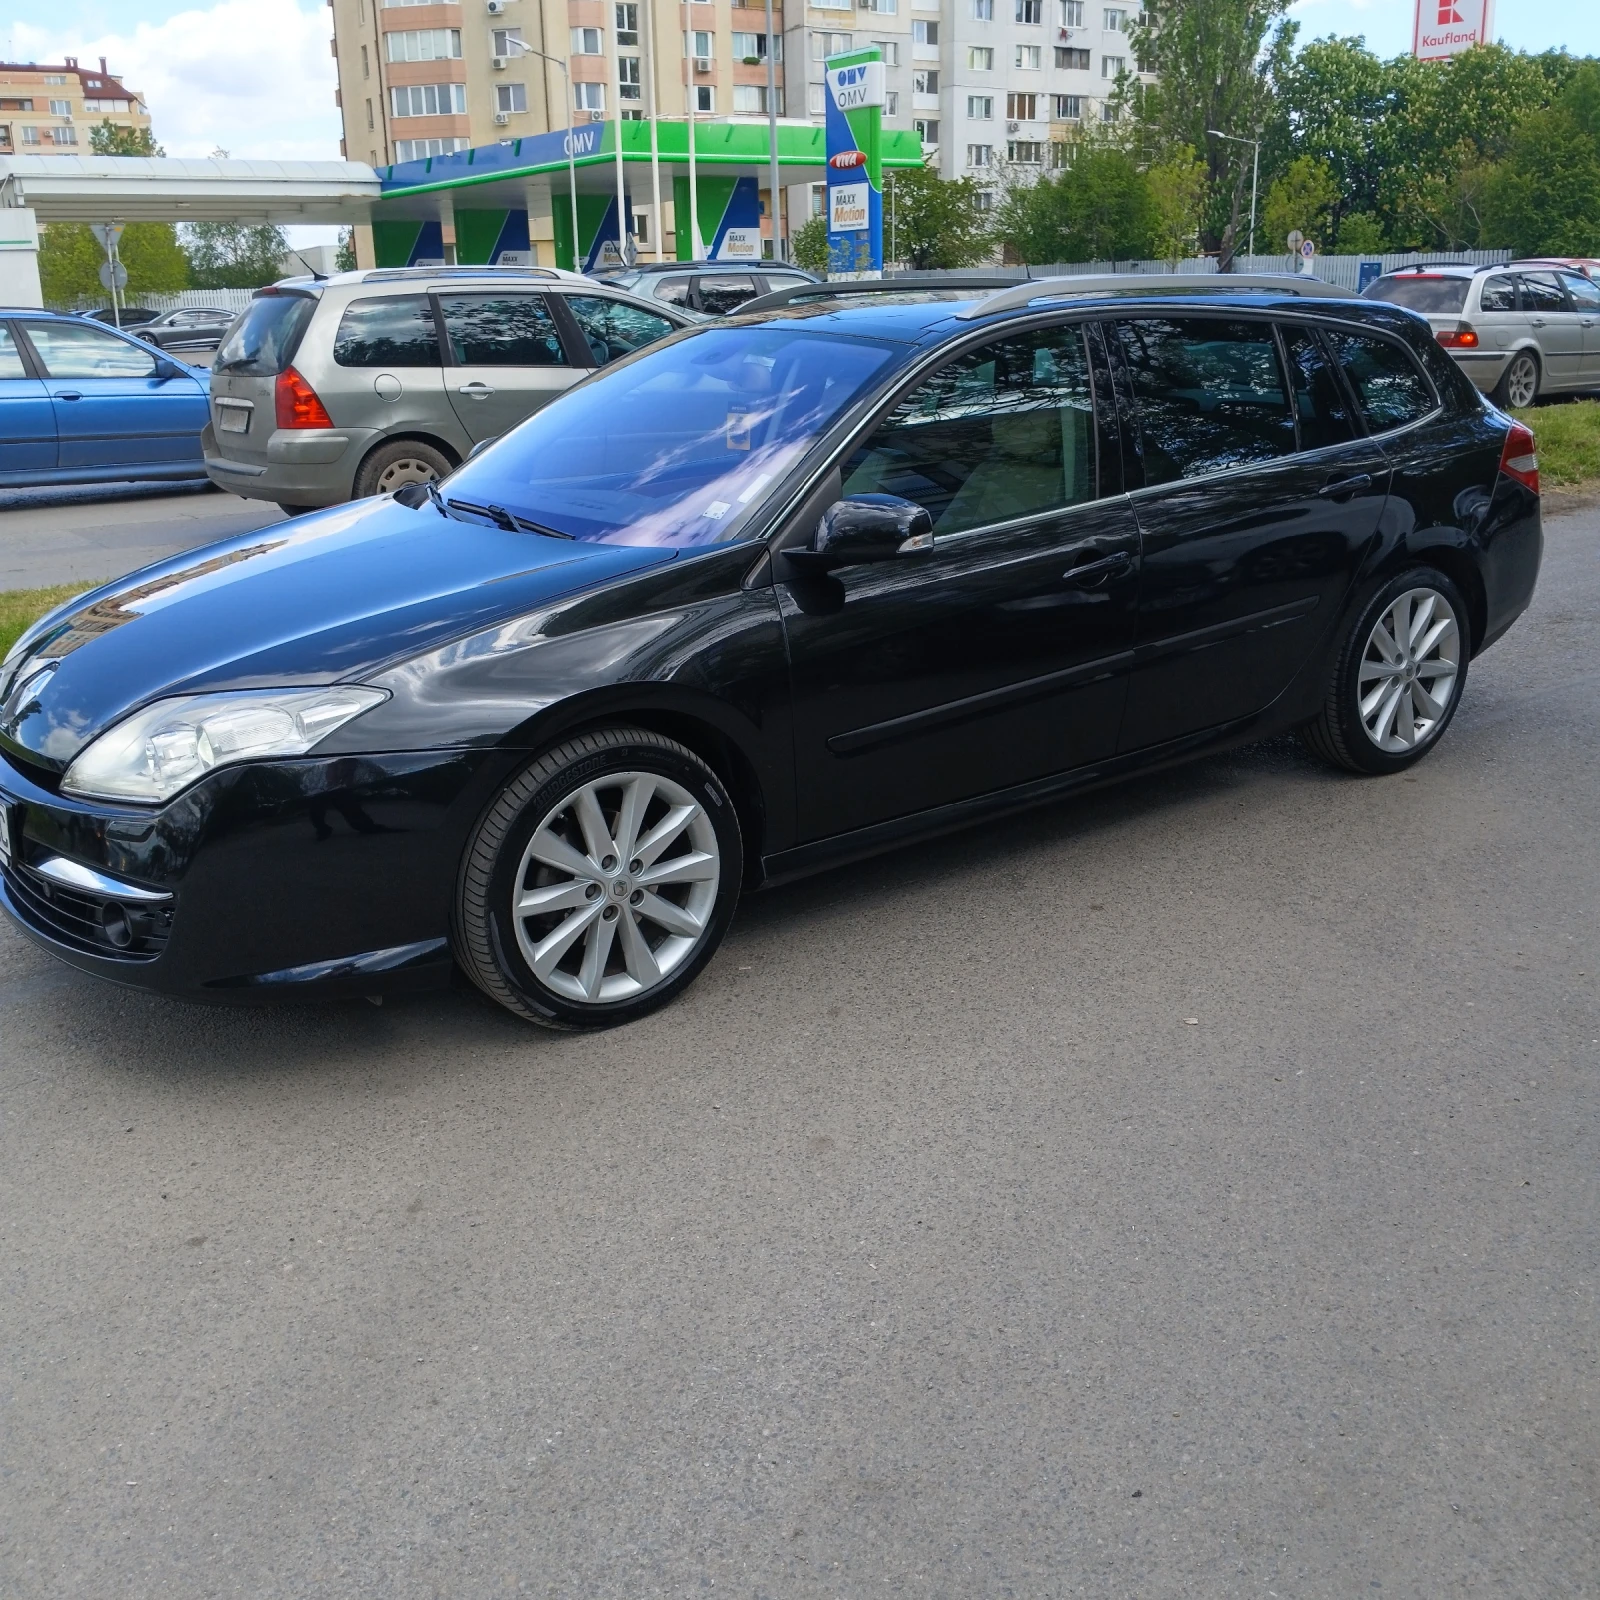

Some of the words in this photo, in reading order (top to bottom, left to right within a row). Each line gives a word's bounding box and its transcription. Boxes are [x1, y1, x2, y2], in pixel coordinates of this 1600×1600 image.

[1422, 29, 1476, 47] Kaufland
[837, 66, 867, 86] OMV
[838, 88, 867, 107] OMV
[836, 193, 856, 206] MAXX
[834, 206, 865, 222] Motion
[727, 242, 754, 252] Motion
[532, 754, 607, 810] BRIDGESTONE
